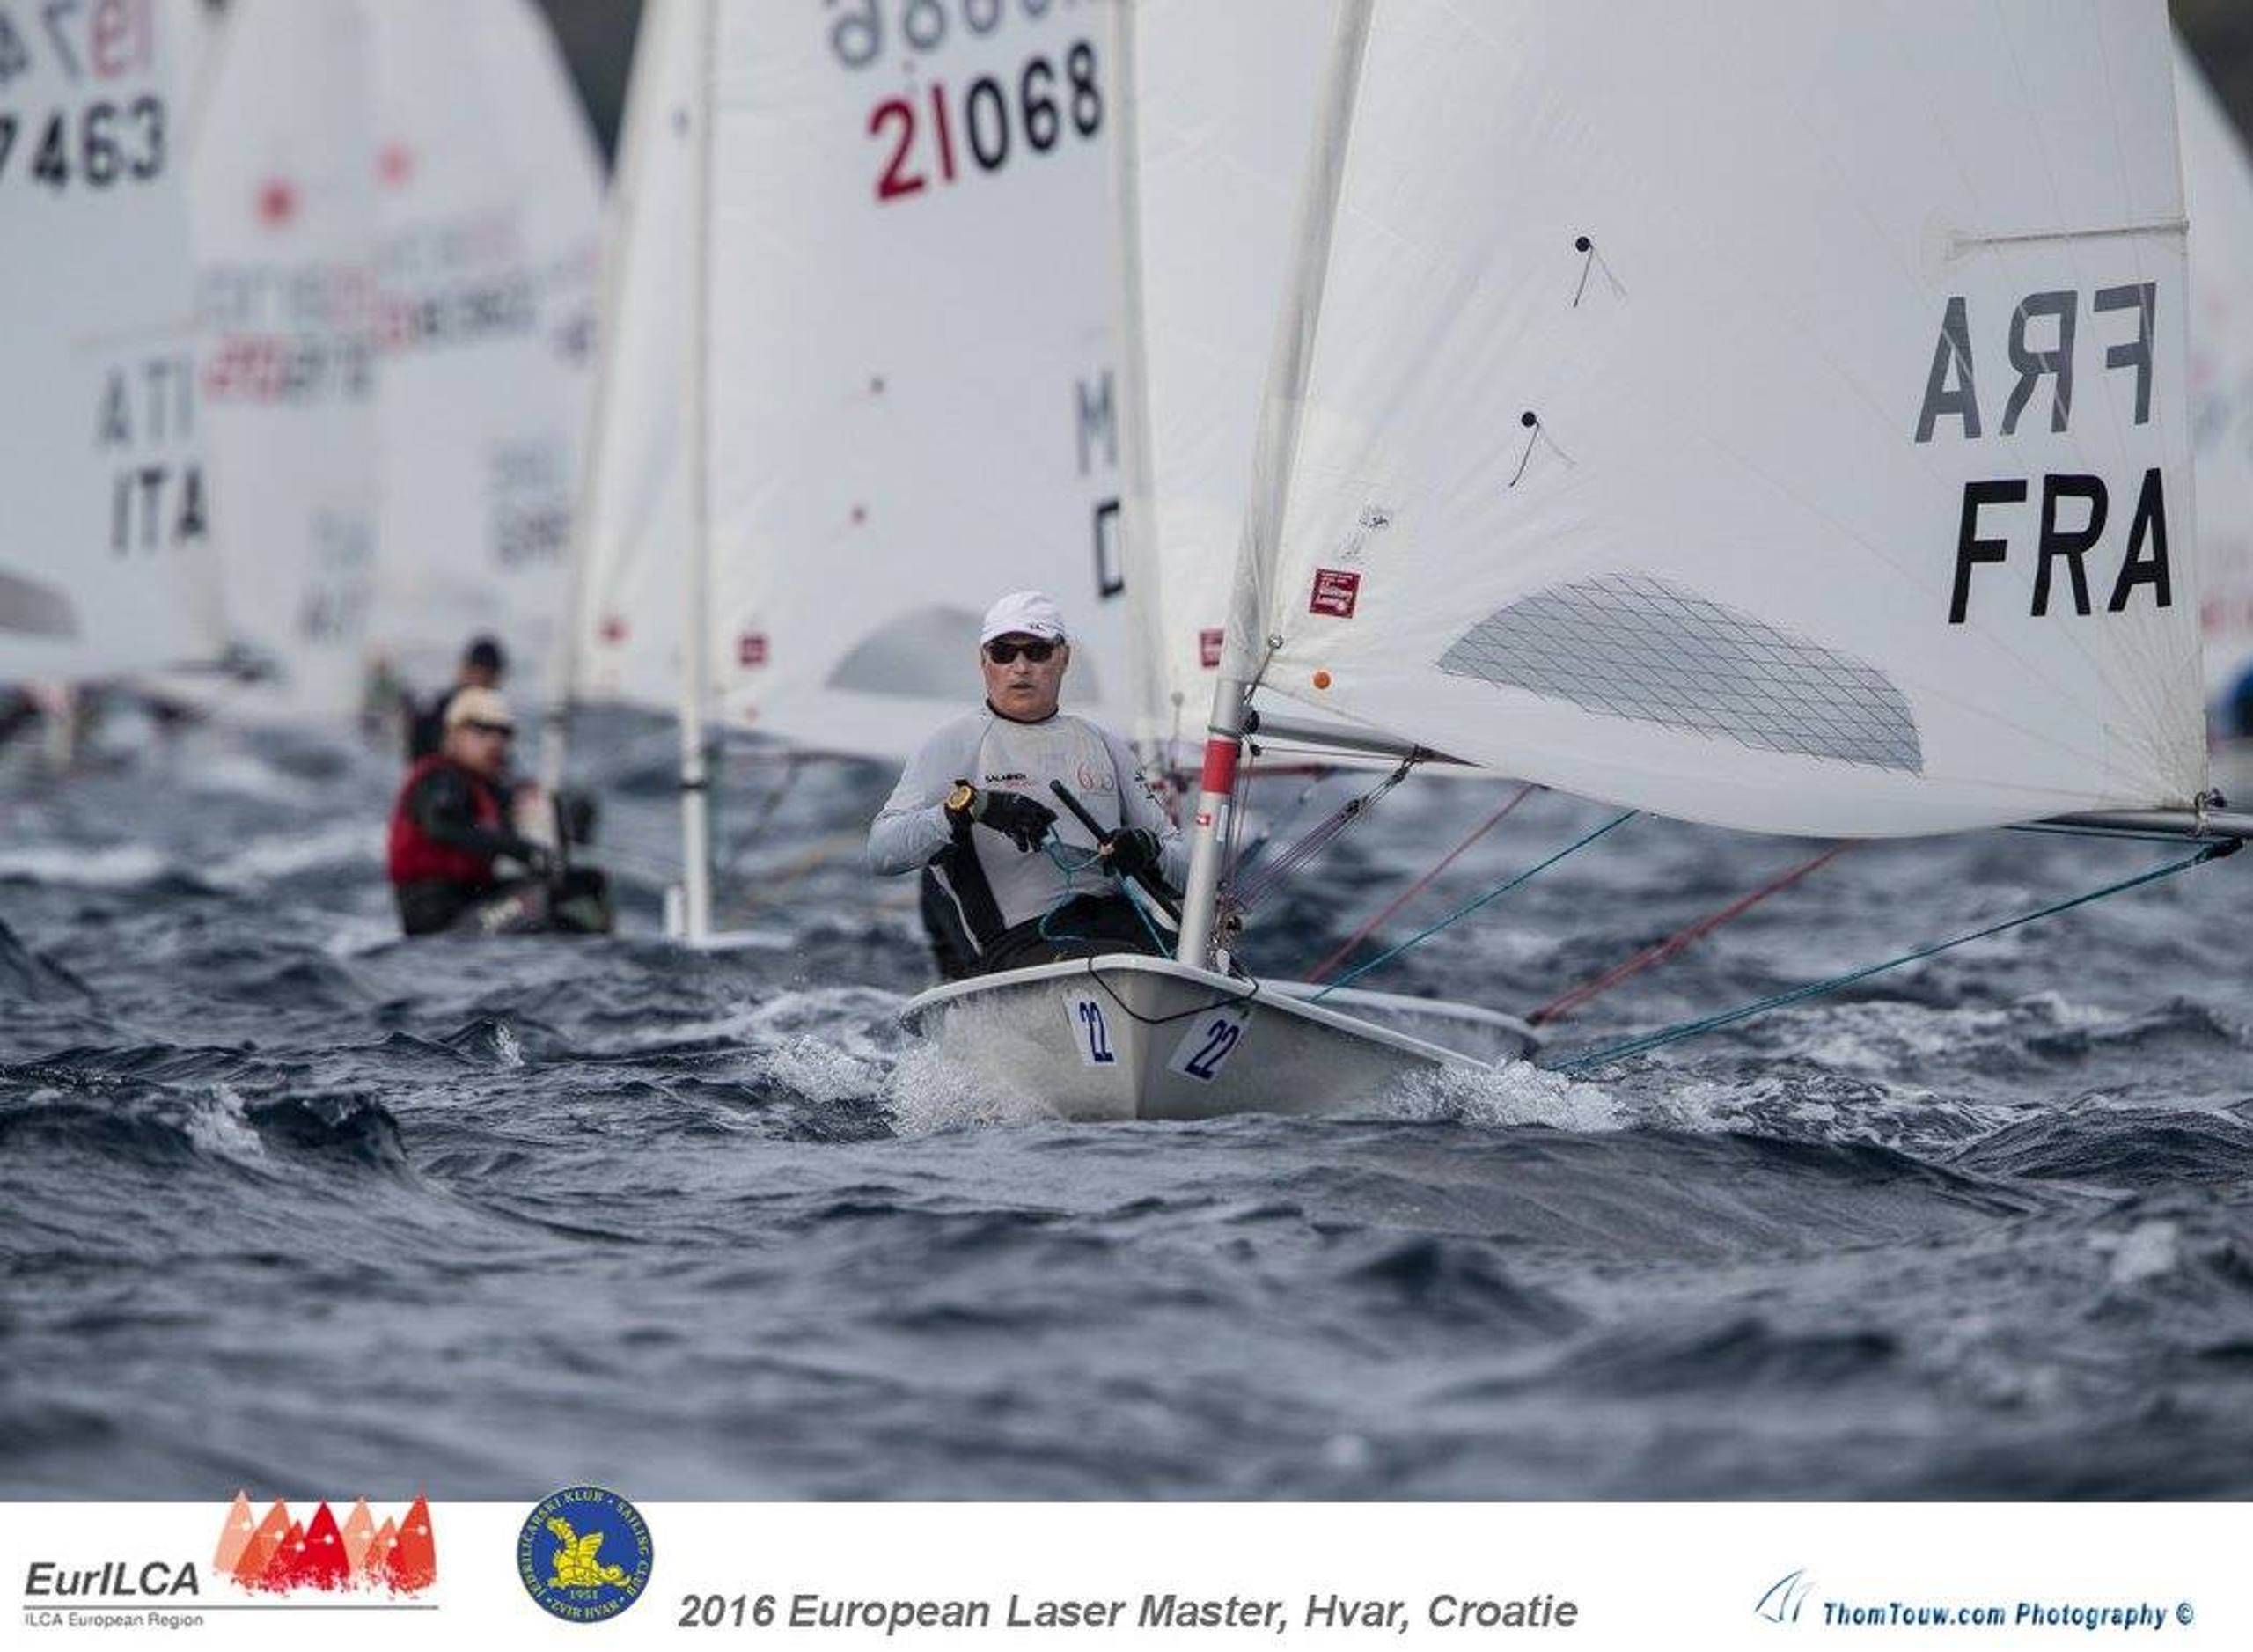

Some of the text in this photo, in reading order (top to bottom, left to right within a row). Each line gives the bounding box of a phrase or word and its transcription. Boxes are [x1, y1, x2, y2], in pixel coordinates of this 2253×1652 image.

[866, 40, 1101, 201] 21068
[107, 459, 209, 559] ITA
[1948, 466, 2172, 625] FRA
[1078, 1001, 1115, 1063] 22
[1184, 1018, 1240, 1081] 22
